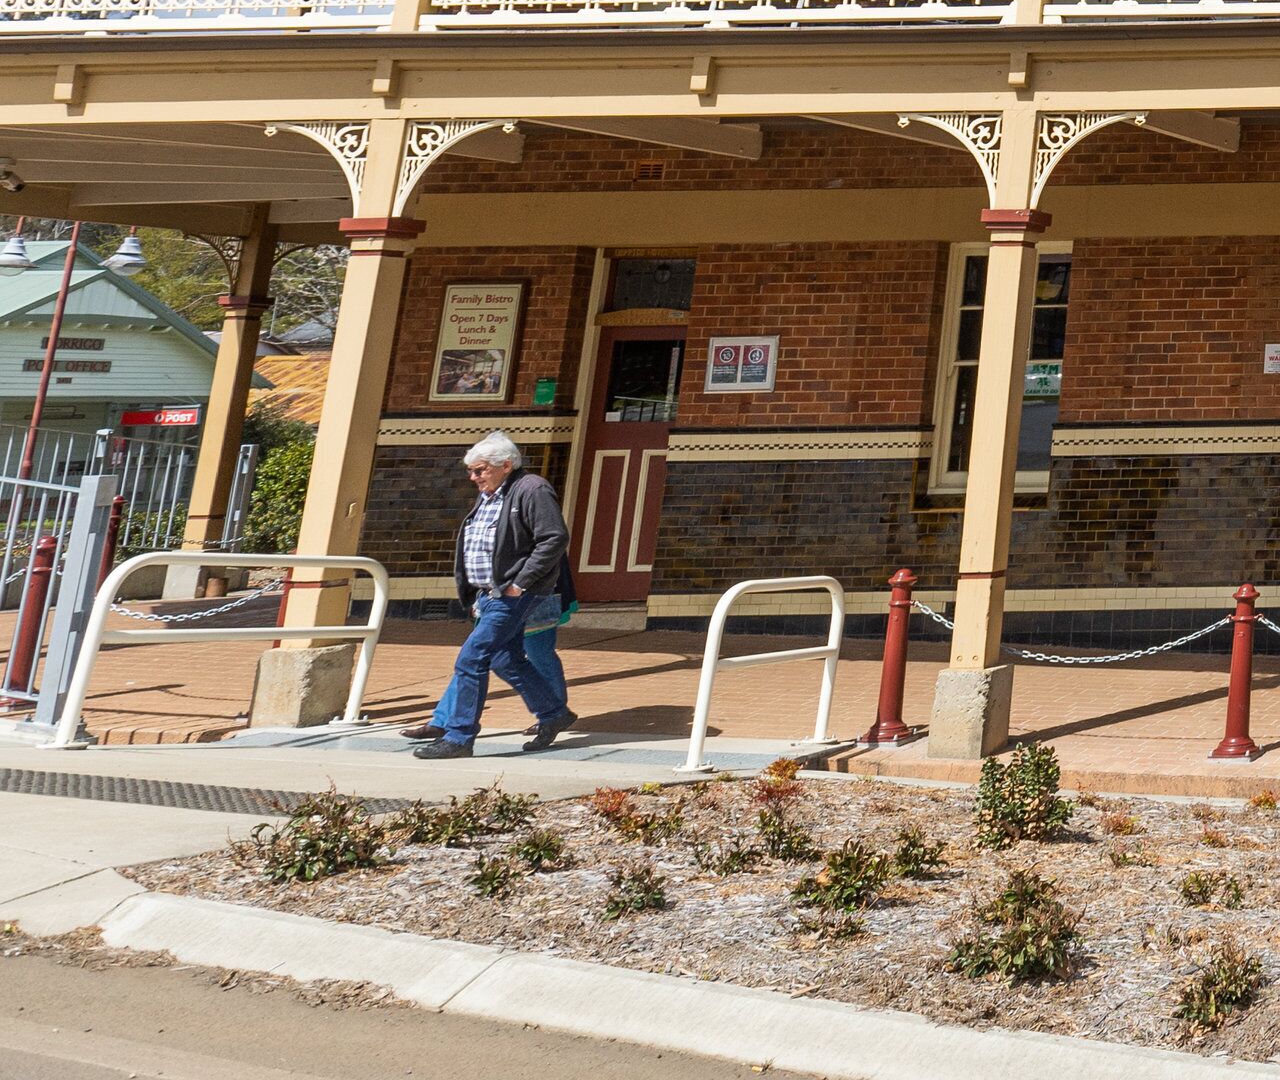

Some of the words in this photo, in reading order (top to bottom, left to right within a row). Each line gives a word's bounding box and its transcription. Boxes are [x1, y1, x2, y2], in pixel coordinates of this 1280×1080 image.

[450, 294, 483, 306] Family
[485, 294, 514, 304] Bistro
[449, 314, 476, 325] Open
[478, 314, 485, 322] 7
[486, 313, 509, 325] Days
[457, 325, 487, 334] Lunch
[488, 325, 497, 333] &
[45, 338, 103, 350] ORRIGO
[459, 336, 492, 345] Dinner
[65, 361, 109, 372] OFFICE
[1031, 364, 1060, 375] ATM
[165, 413, 193, 423] POST
